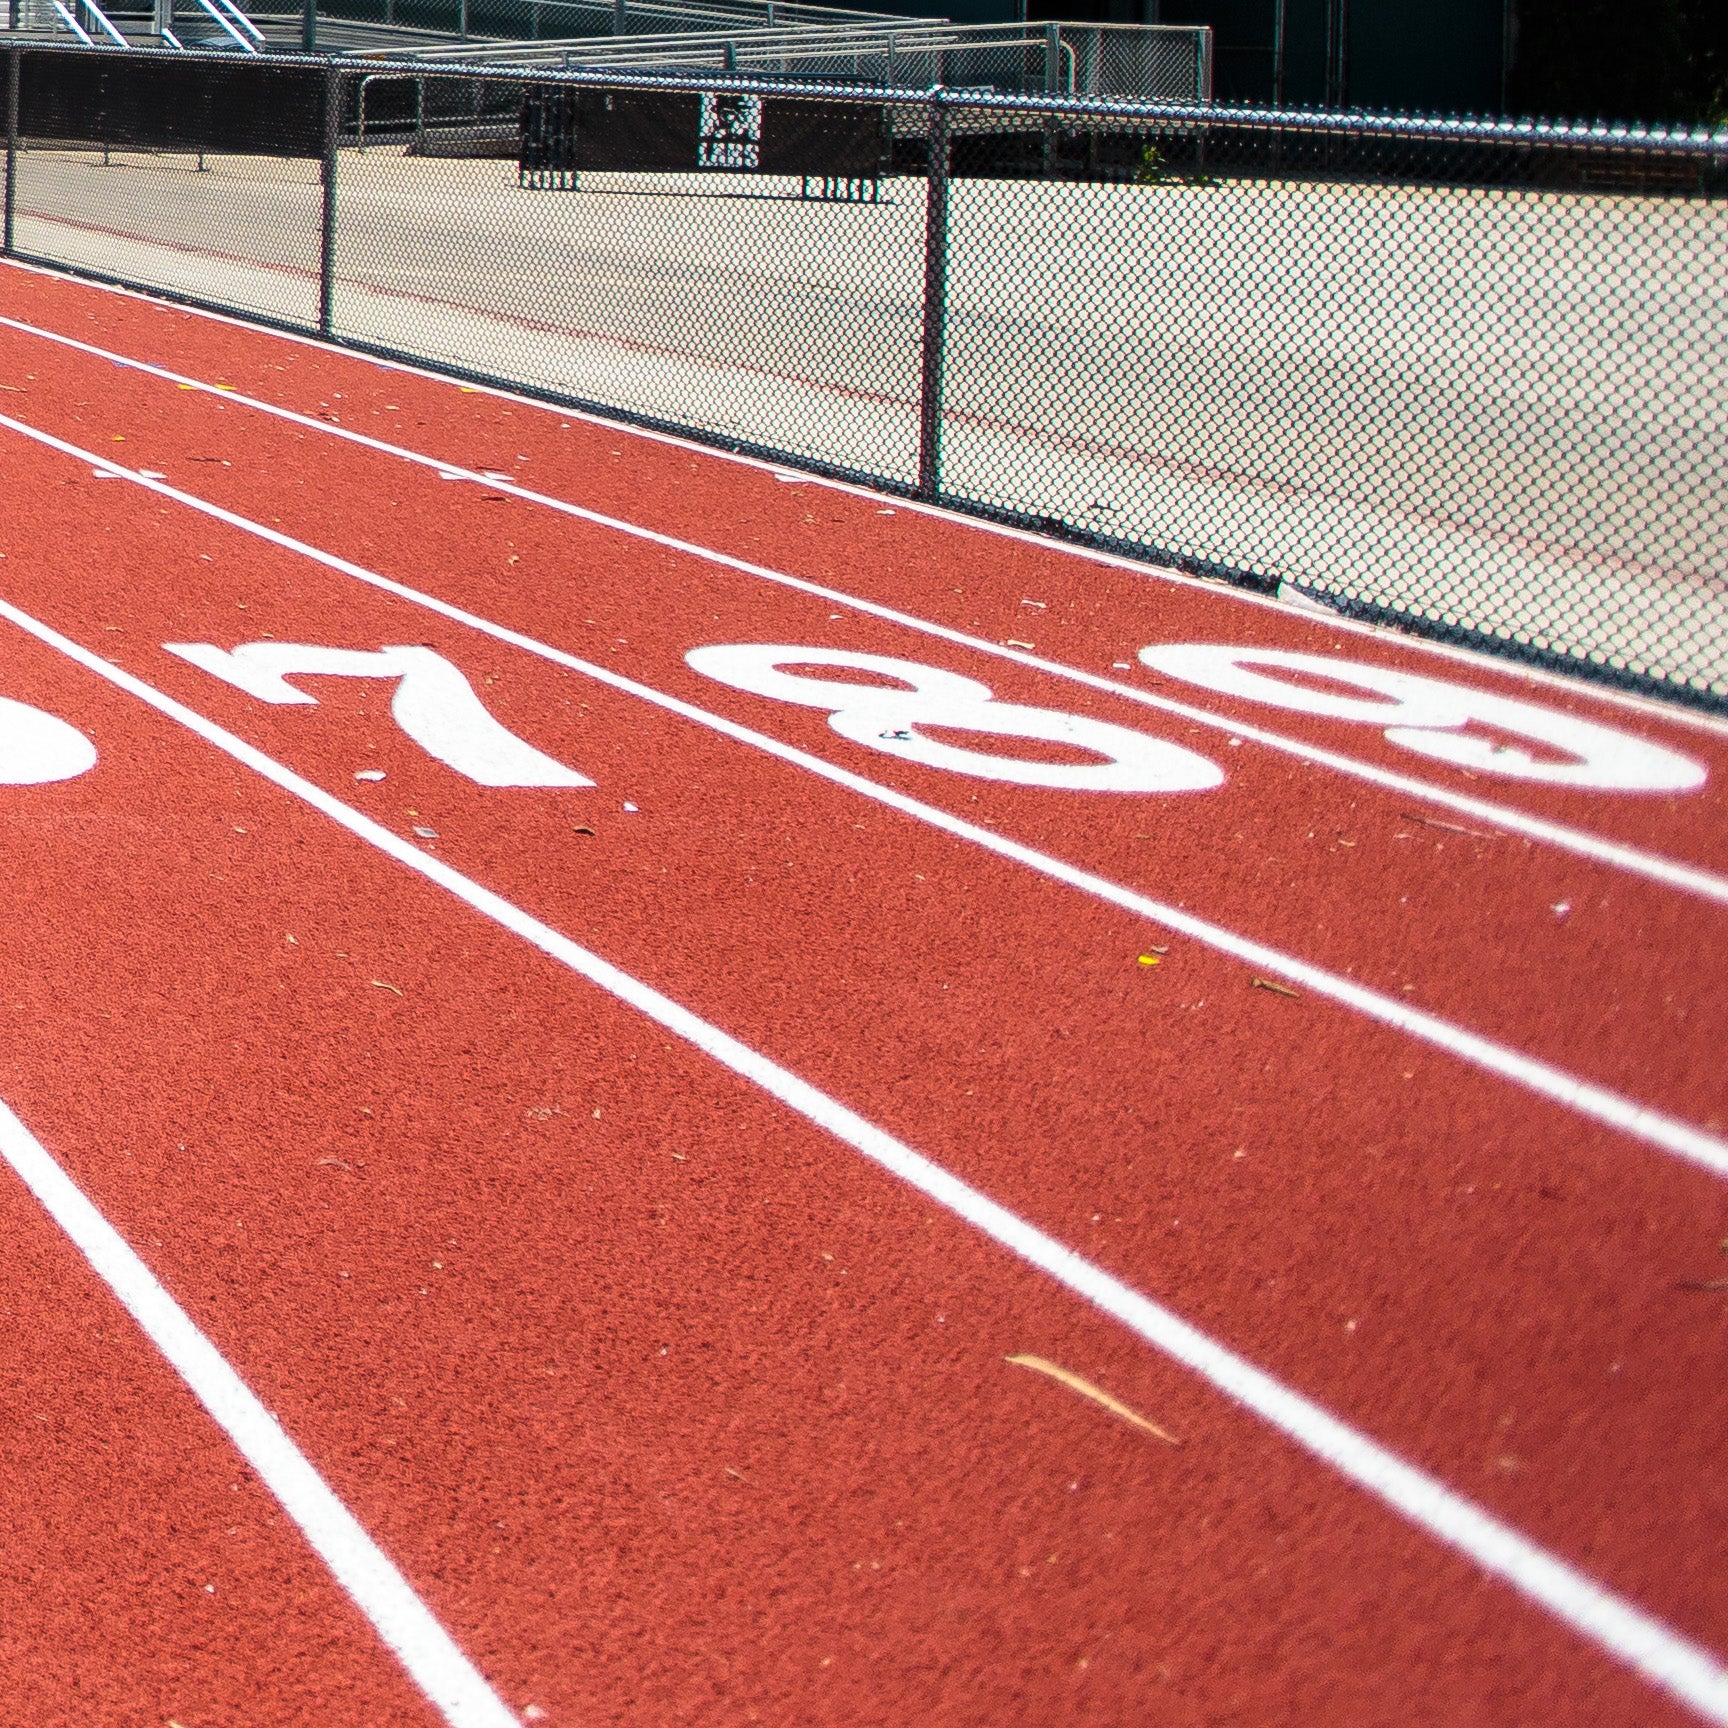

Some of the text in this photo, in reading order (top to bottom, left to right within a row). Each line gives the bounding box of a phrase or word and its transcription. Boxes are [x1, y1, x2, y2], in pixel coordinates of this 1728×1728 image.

[162, 641, 596, 787] 7
[684, 643, 1224, 794] 8
[1138, 642, 1707, 793] 9
